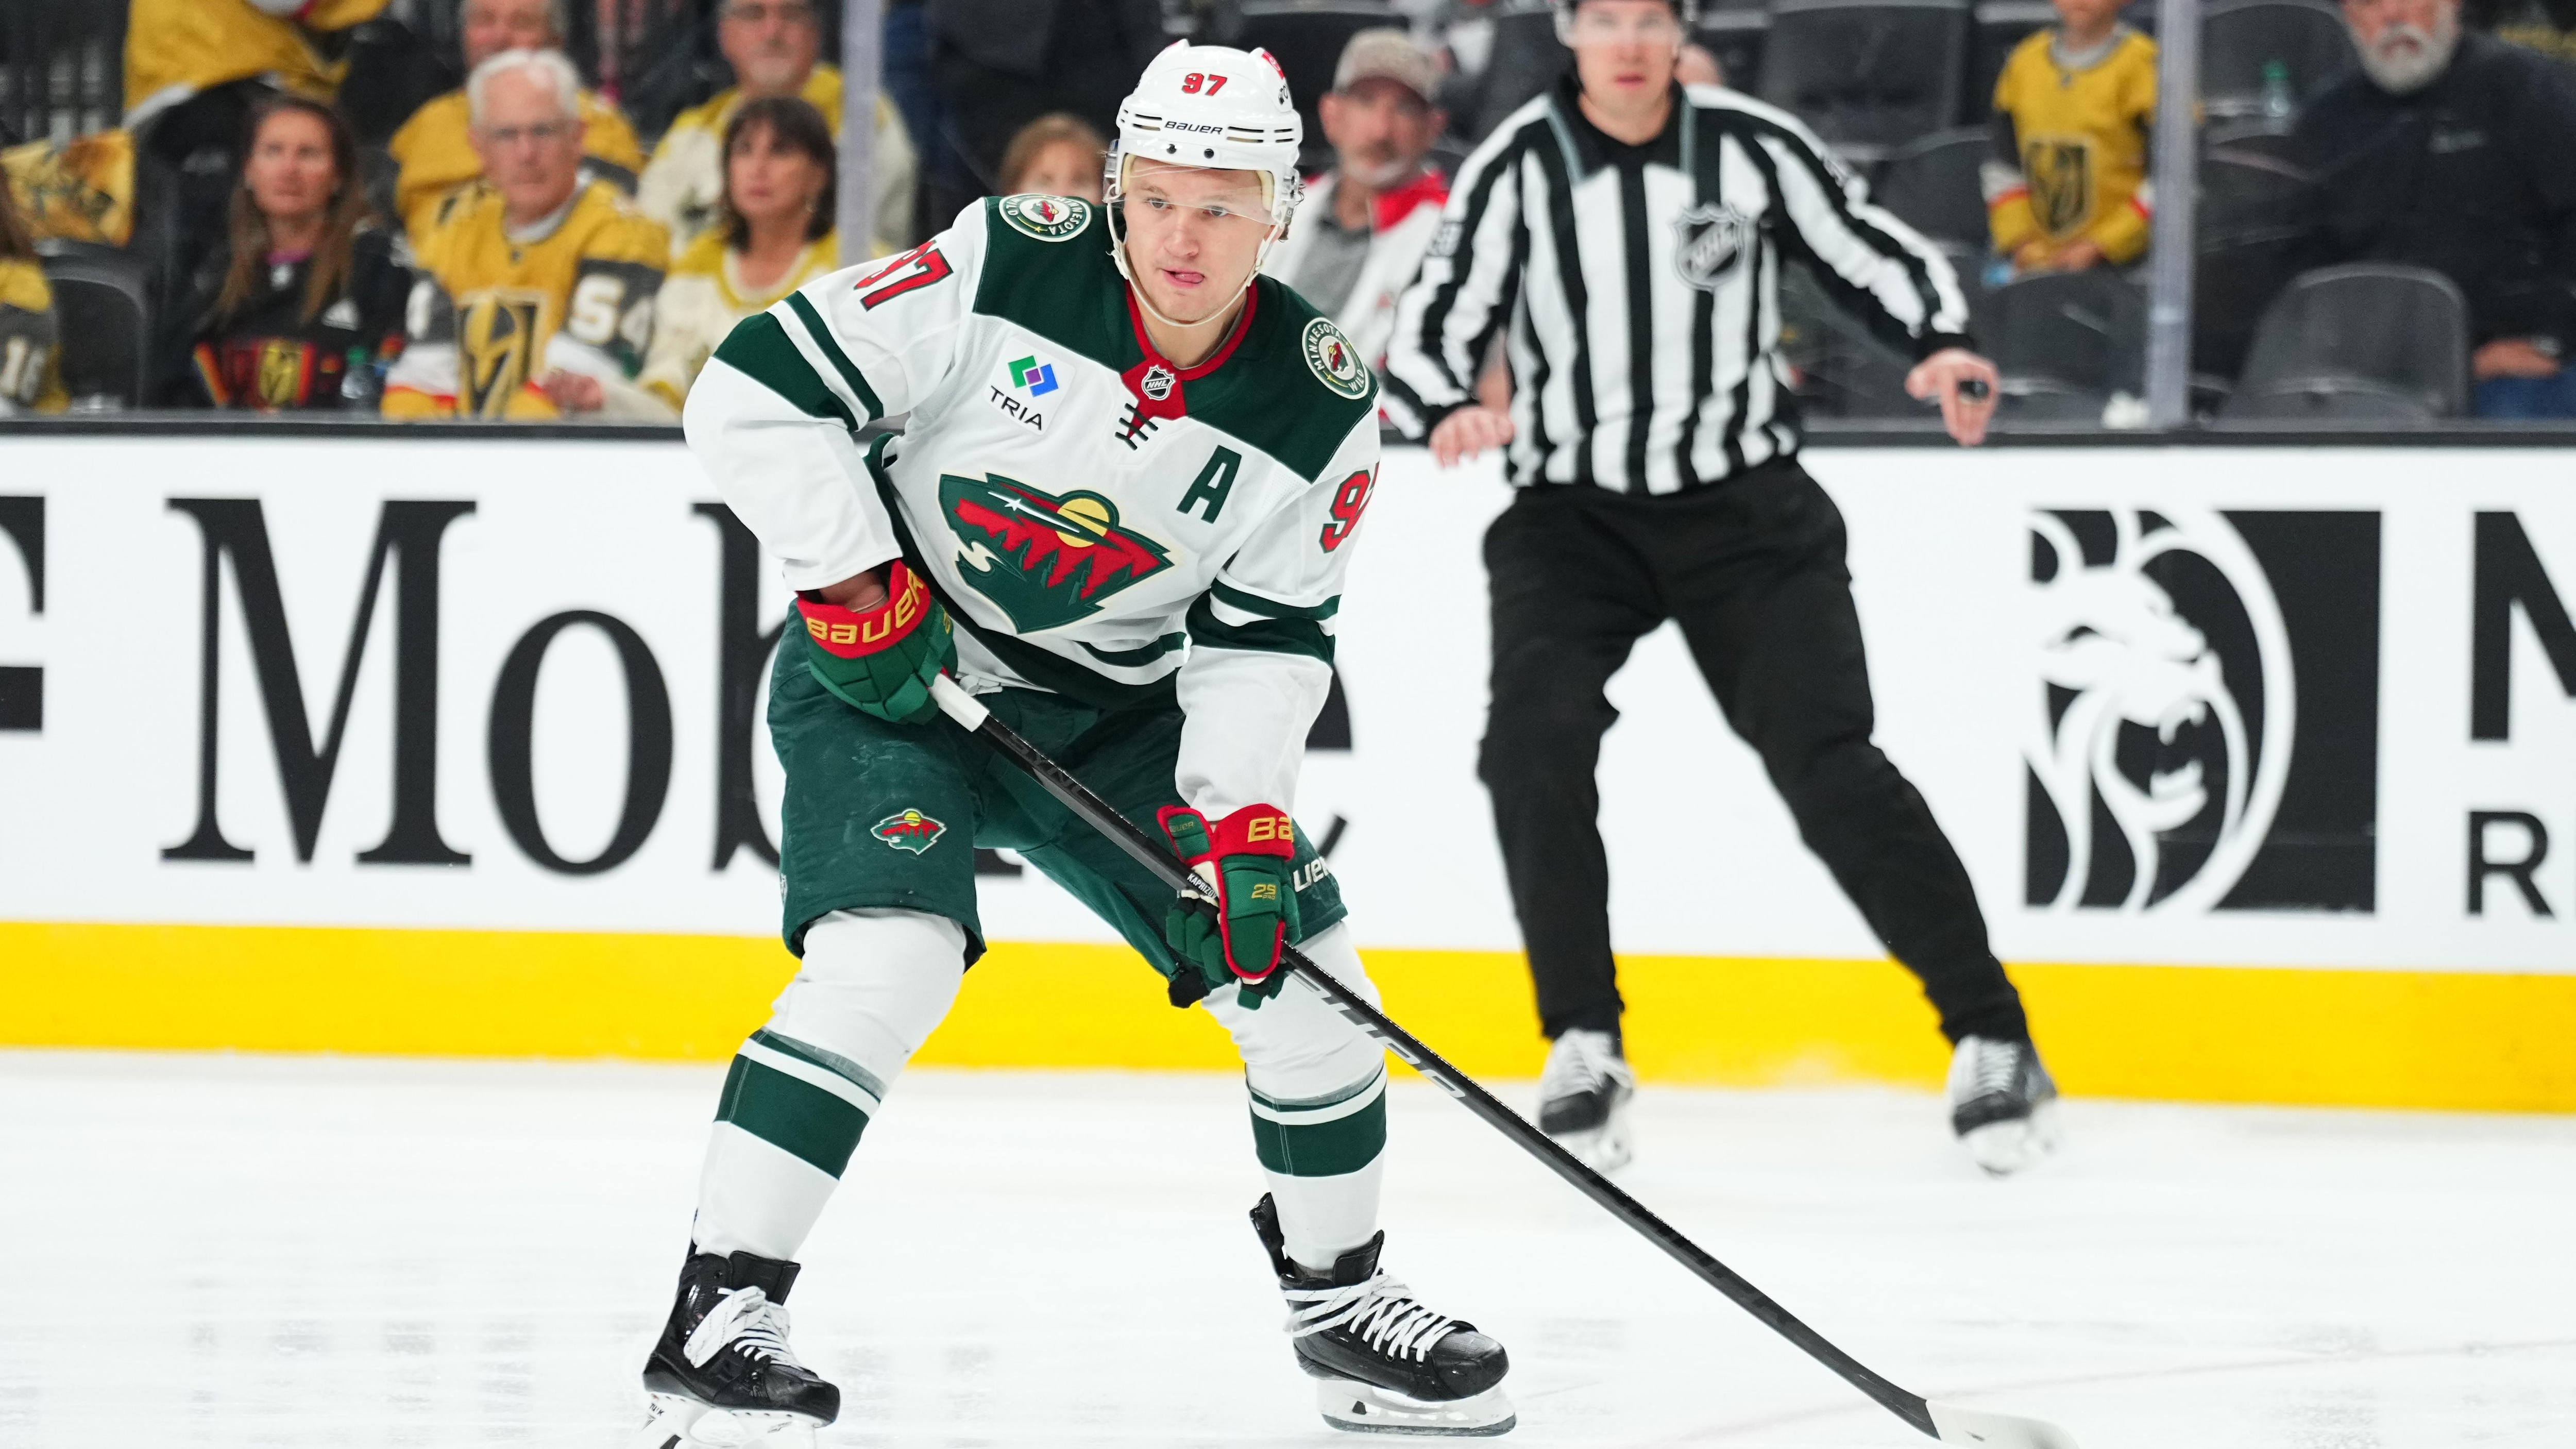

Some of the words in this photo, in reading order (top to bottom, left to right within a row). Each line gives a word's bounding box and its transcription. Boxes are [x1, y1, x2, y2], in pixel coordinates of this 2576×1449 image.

[1182, 73, 1227, 96] 97
[1164, 121, 1223, 135] BAUER
[1006, 198, 1022, 216] WILD
[1048, 197, 1083, 235] MINNESOTA
[1308, 324, 1340, 371] MINNESOTA
[1146, 379, 1168, 389] NHL
[1348, 369, 1364, 392] WILD
[990, 385, 1042, 430] TRIA
[1176, 445, 1242, 524] A
[1319, 461, 1380, 554] 9
[806, 568, 924, 644] BAUER
[1187, 873, 1217, 899] KAPRIZOV
